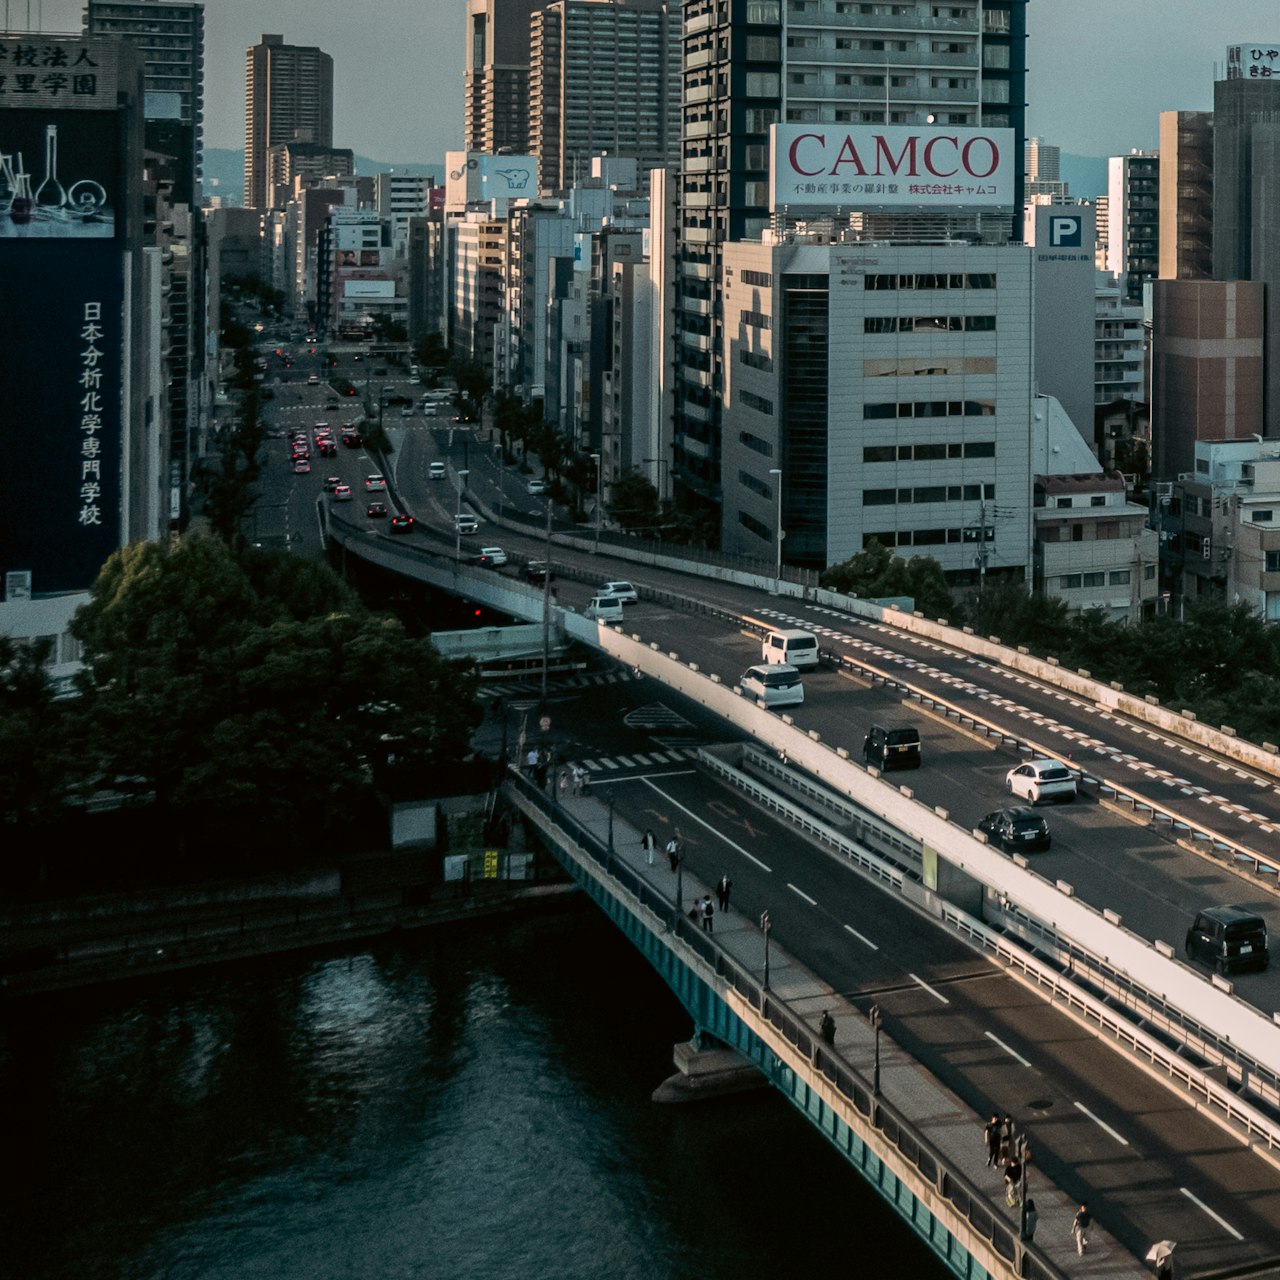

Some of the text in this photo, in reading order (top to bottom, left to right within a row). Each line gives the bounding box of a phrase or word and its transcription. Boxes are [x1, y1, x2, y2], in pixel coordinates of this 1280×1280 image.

[1250, 48, 1279, 61] ひや
[0, 73, 97, 96] 里学園
[788, 133, 1000, 179] CAMCO
[792, 183, 998, 196] 不動産事業の羅針盤 株式会社キャムコ
[1053, 218, 1078, 245] P
[78, 301, 105, 526] 日本分析化学専門学校
